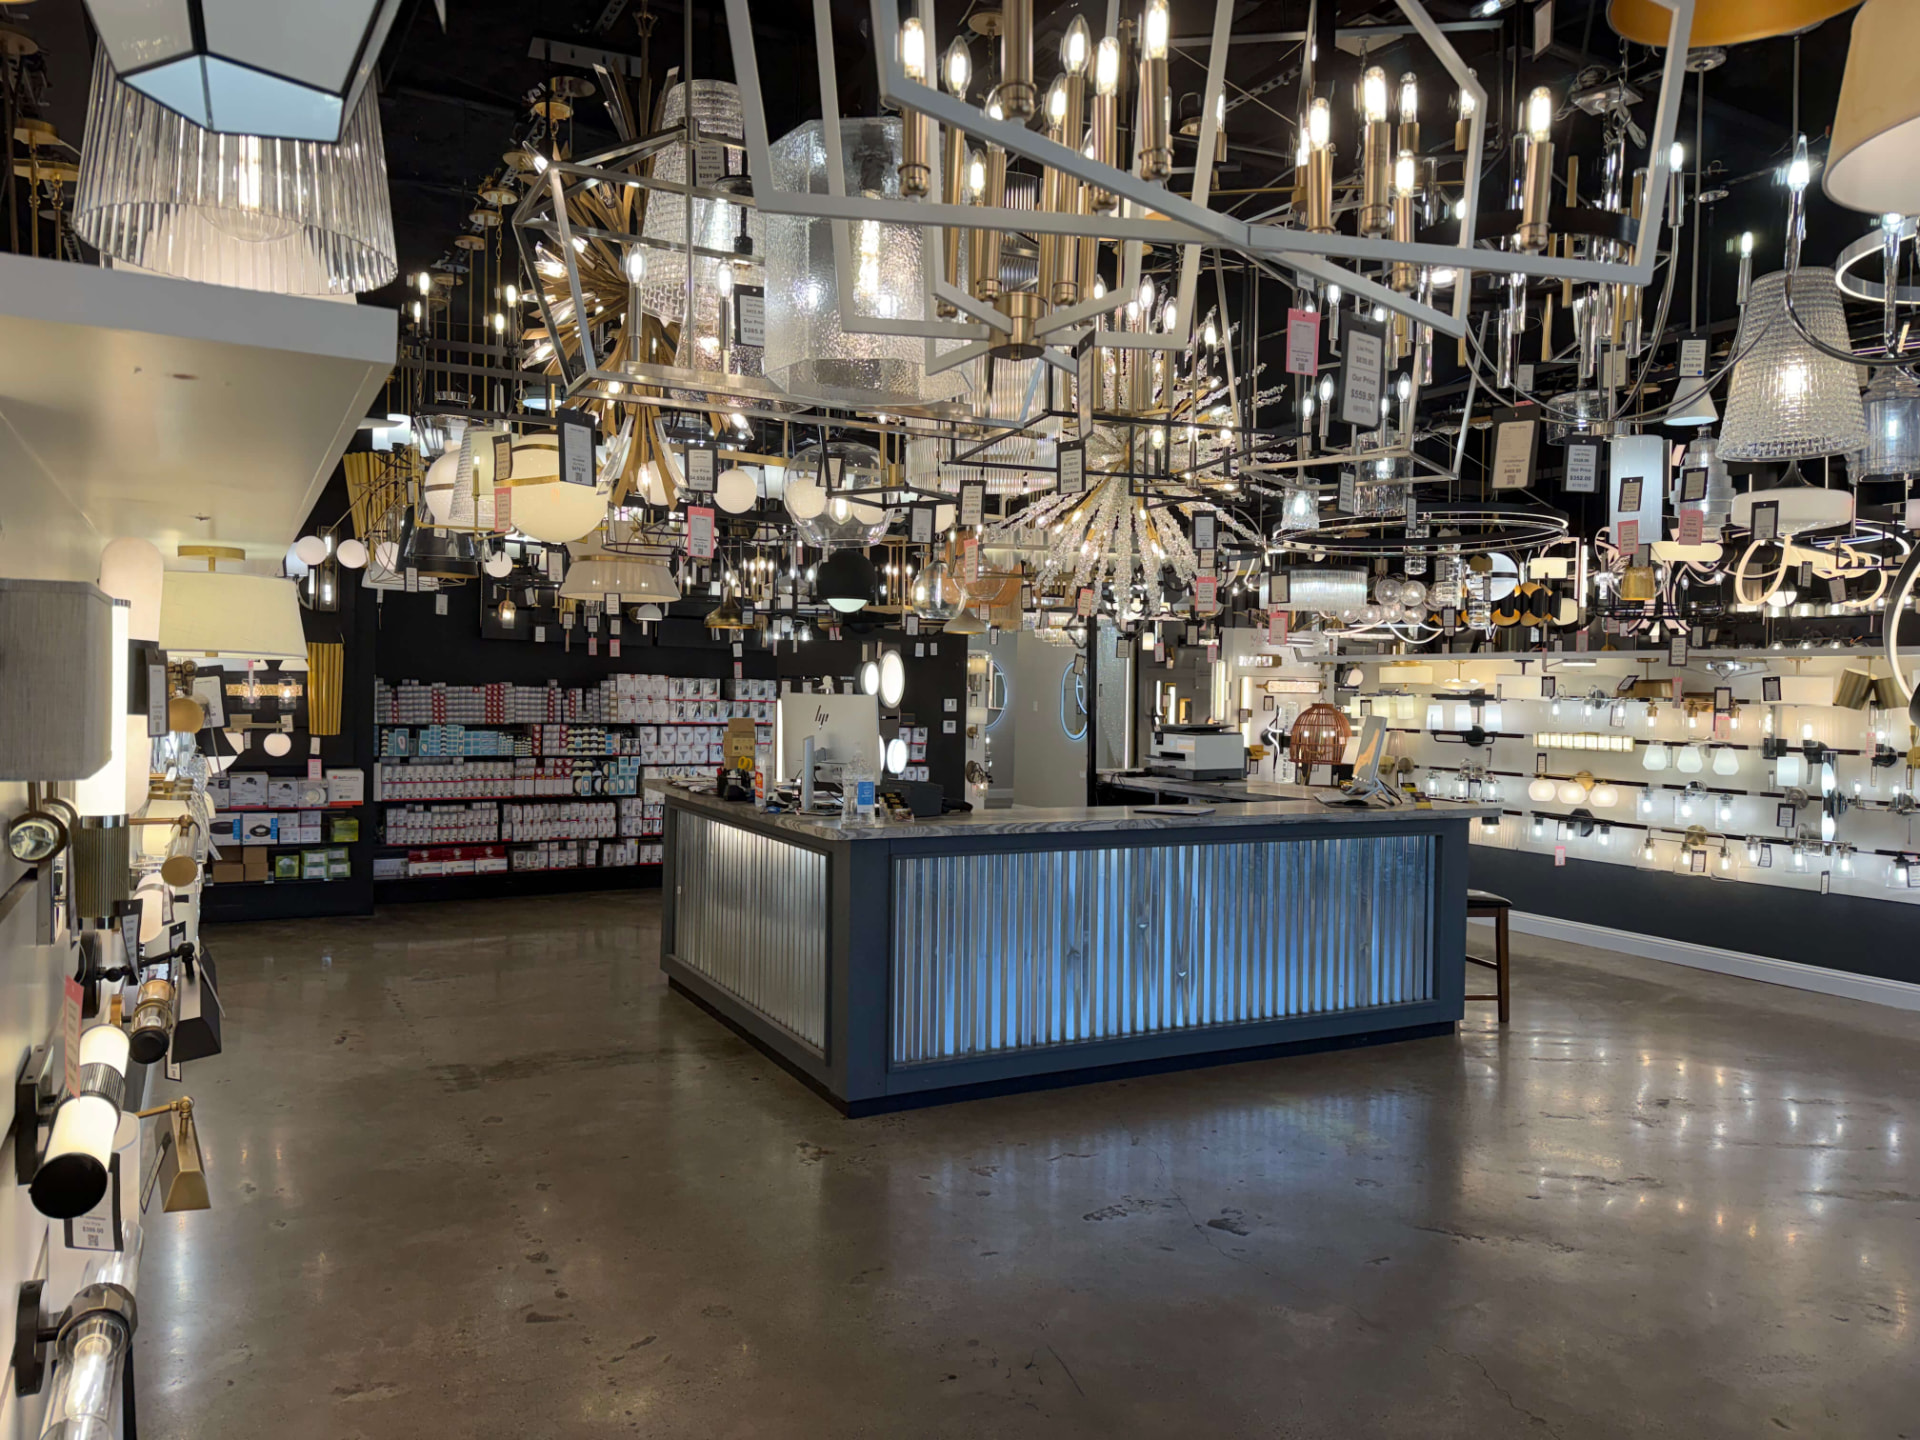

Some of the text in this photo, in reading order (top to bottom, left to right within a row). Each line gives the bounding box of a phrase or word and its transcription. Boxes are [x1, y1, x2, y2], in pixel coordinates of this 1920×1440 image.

[1352, 374, 1376, 386] Our Price
[1351, 389, 1375, 402] $559.90
[814, 705, 829, 729] hp
